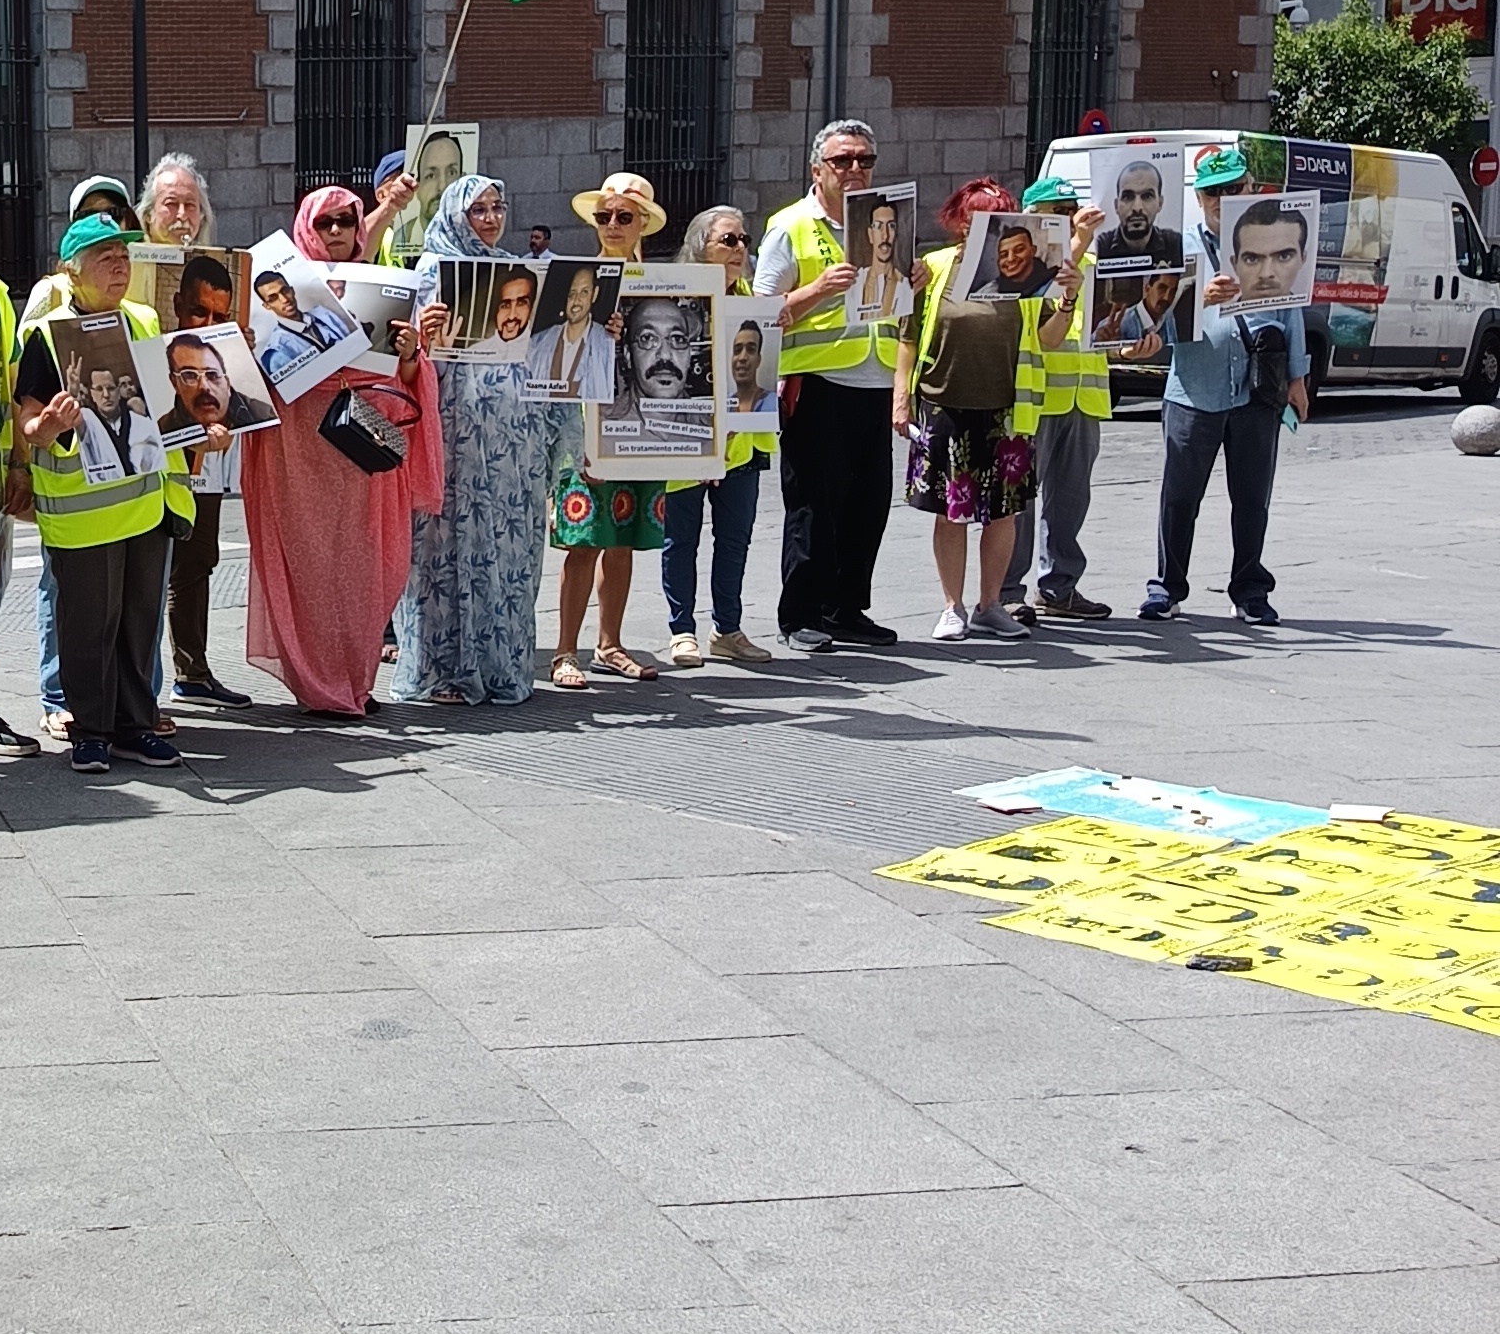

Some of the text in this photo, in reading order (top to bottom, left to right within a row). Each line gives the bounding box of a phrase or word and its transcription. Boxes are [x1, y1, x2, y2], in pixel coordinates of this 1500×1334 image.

[812, 227, 836, 267] SAHA
[655, 283, 686, 292] perpetua
[642, 402, 674, 410] deterioro
[604, 424, 613, 433] Se
[618, 444, 698, 453] Sin tratamiento médico
